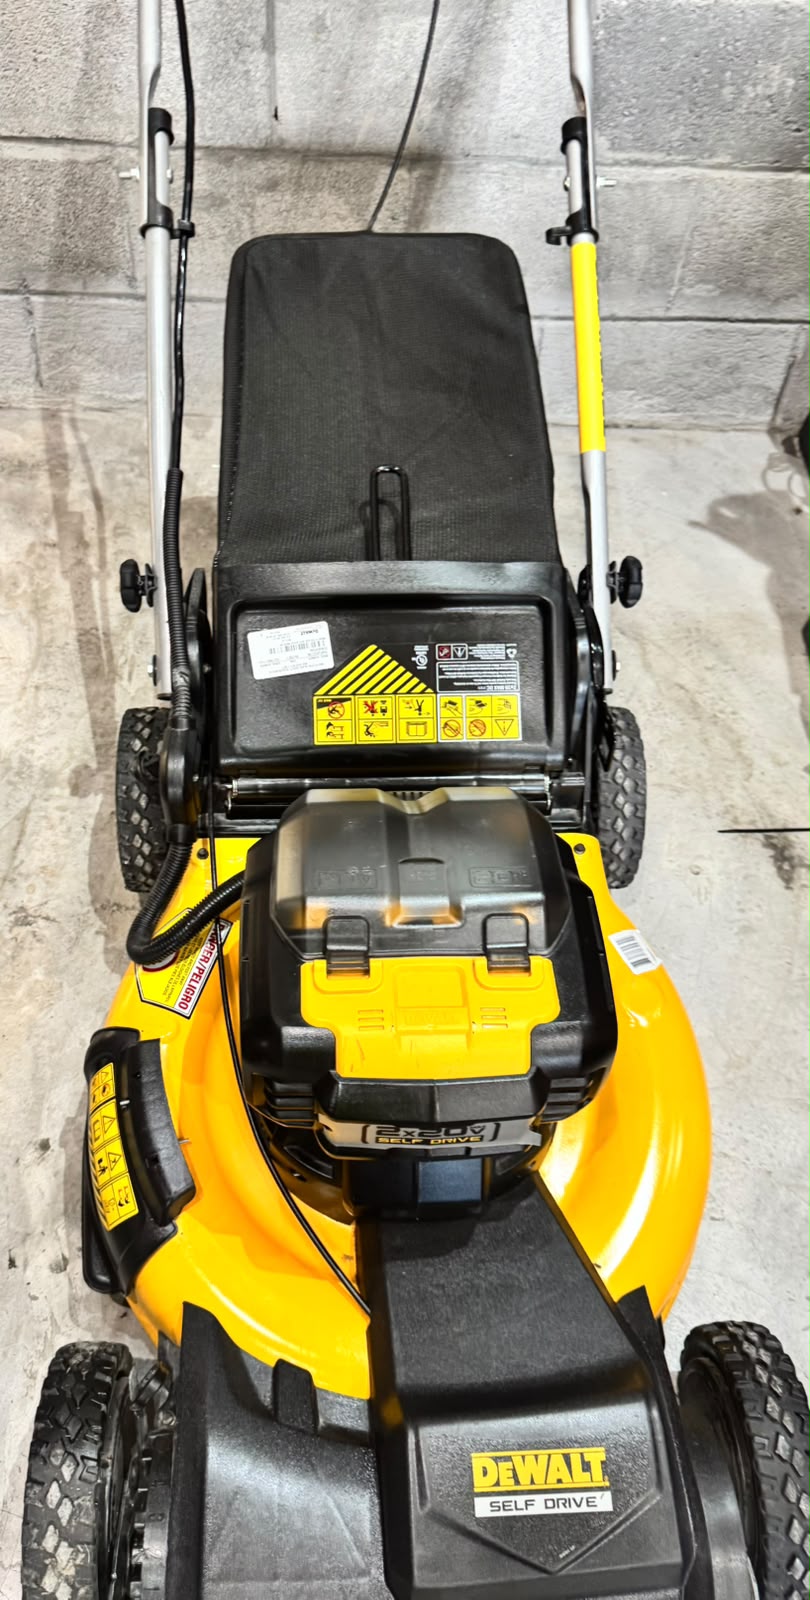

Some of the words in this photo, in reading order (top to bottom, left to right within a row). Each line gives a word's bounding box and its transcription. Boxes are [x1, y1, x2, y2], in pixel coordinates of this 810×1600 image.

[430, 1137, 481, 1145] DRIVE
[471, 1451, 607, 1489] DEWALT
[490, 1499, 536, 1512] SELF
[544, 1496, 598, 1509] DRIVE
